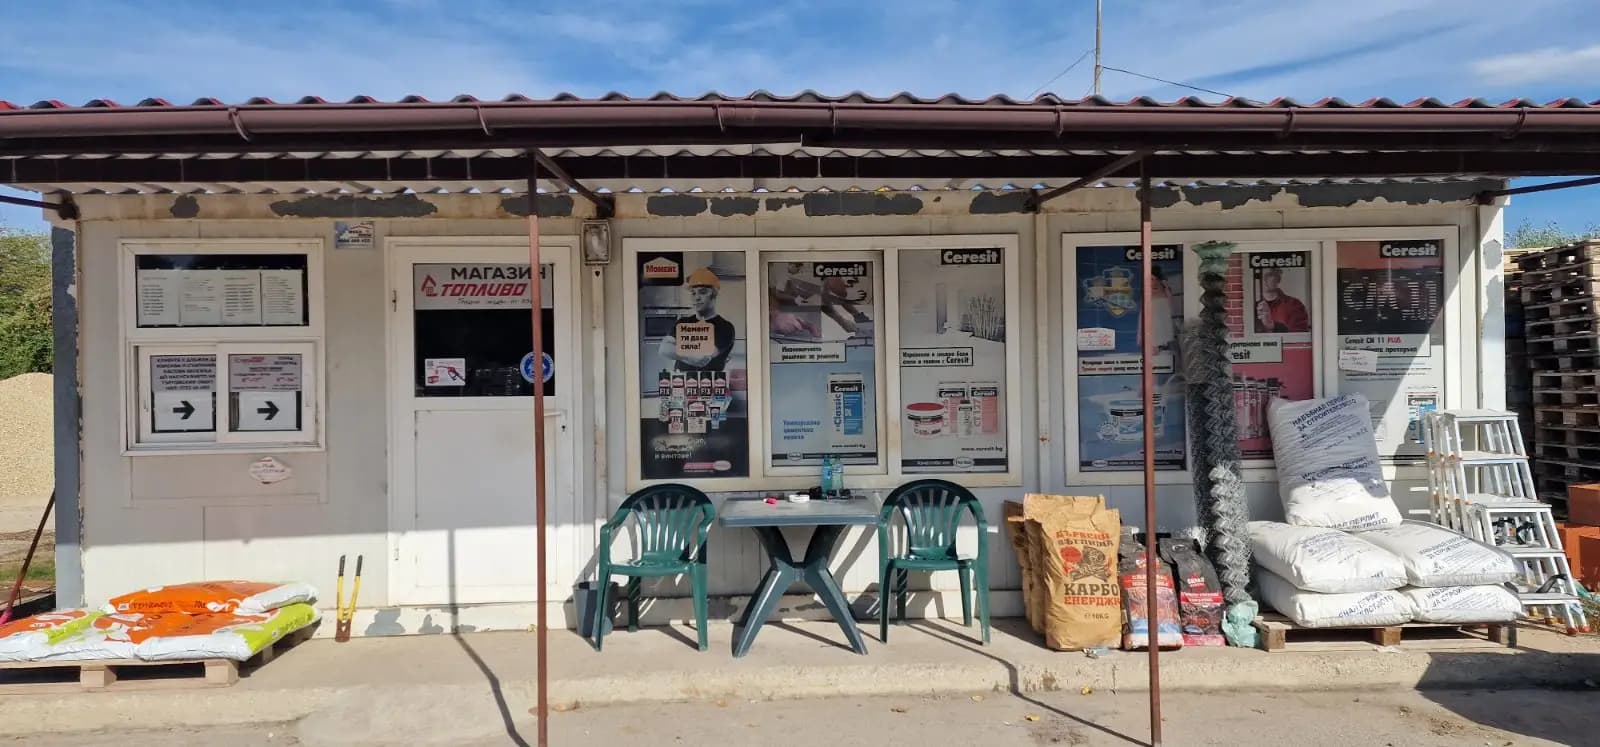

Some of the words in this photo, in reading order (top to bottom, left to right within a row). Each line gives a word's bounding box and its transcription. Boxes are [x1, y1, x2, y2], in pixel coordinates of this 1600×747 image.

[944, 250, 999, 263] Ceresit
[1126, 249, 1175, 260] Ceesit
[1382, 244, 1437, 257] Ceresit
[1251, 253, 1303, 267] Ceresit
[451, 266, 546, 280] МАГАЗИН
[815, 264, 865, 276] Ceresit
[440, 283, 528, 296] ТОПЛИВО
[946, 356, 969, 364] Ceresit
[1064, 584, 1119, 595] КАРБО
